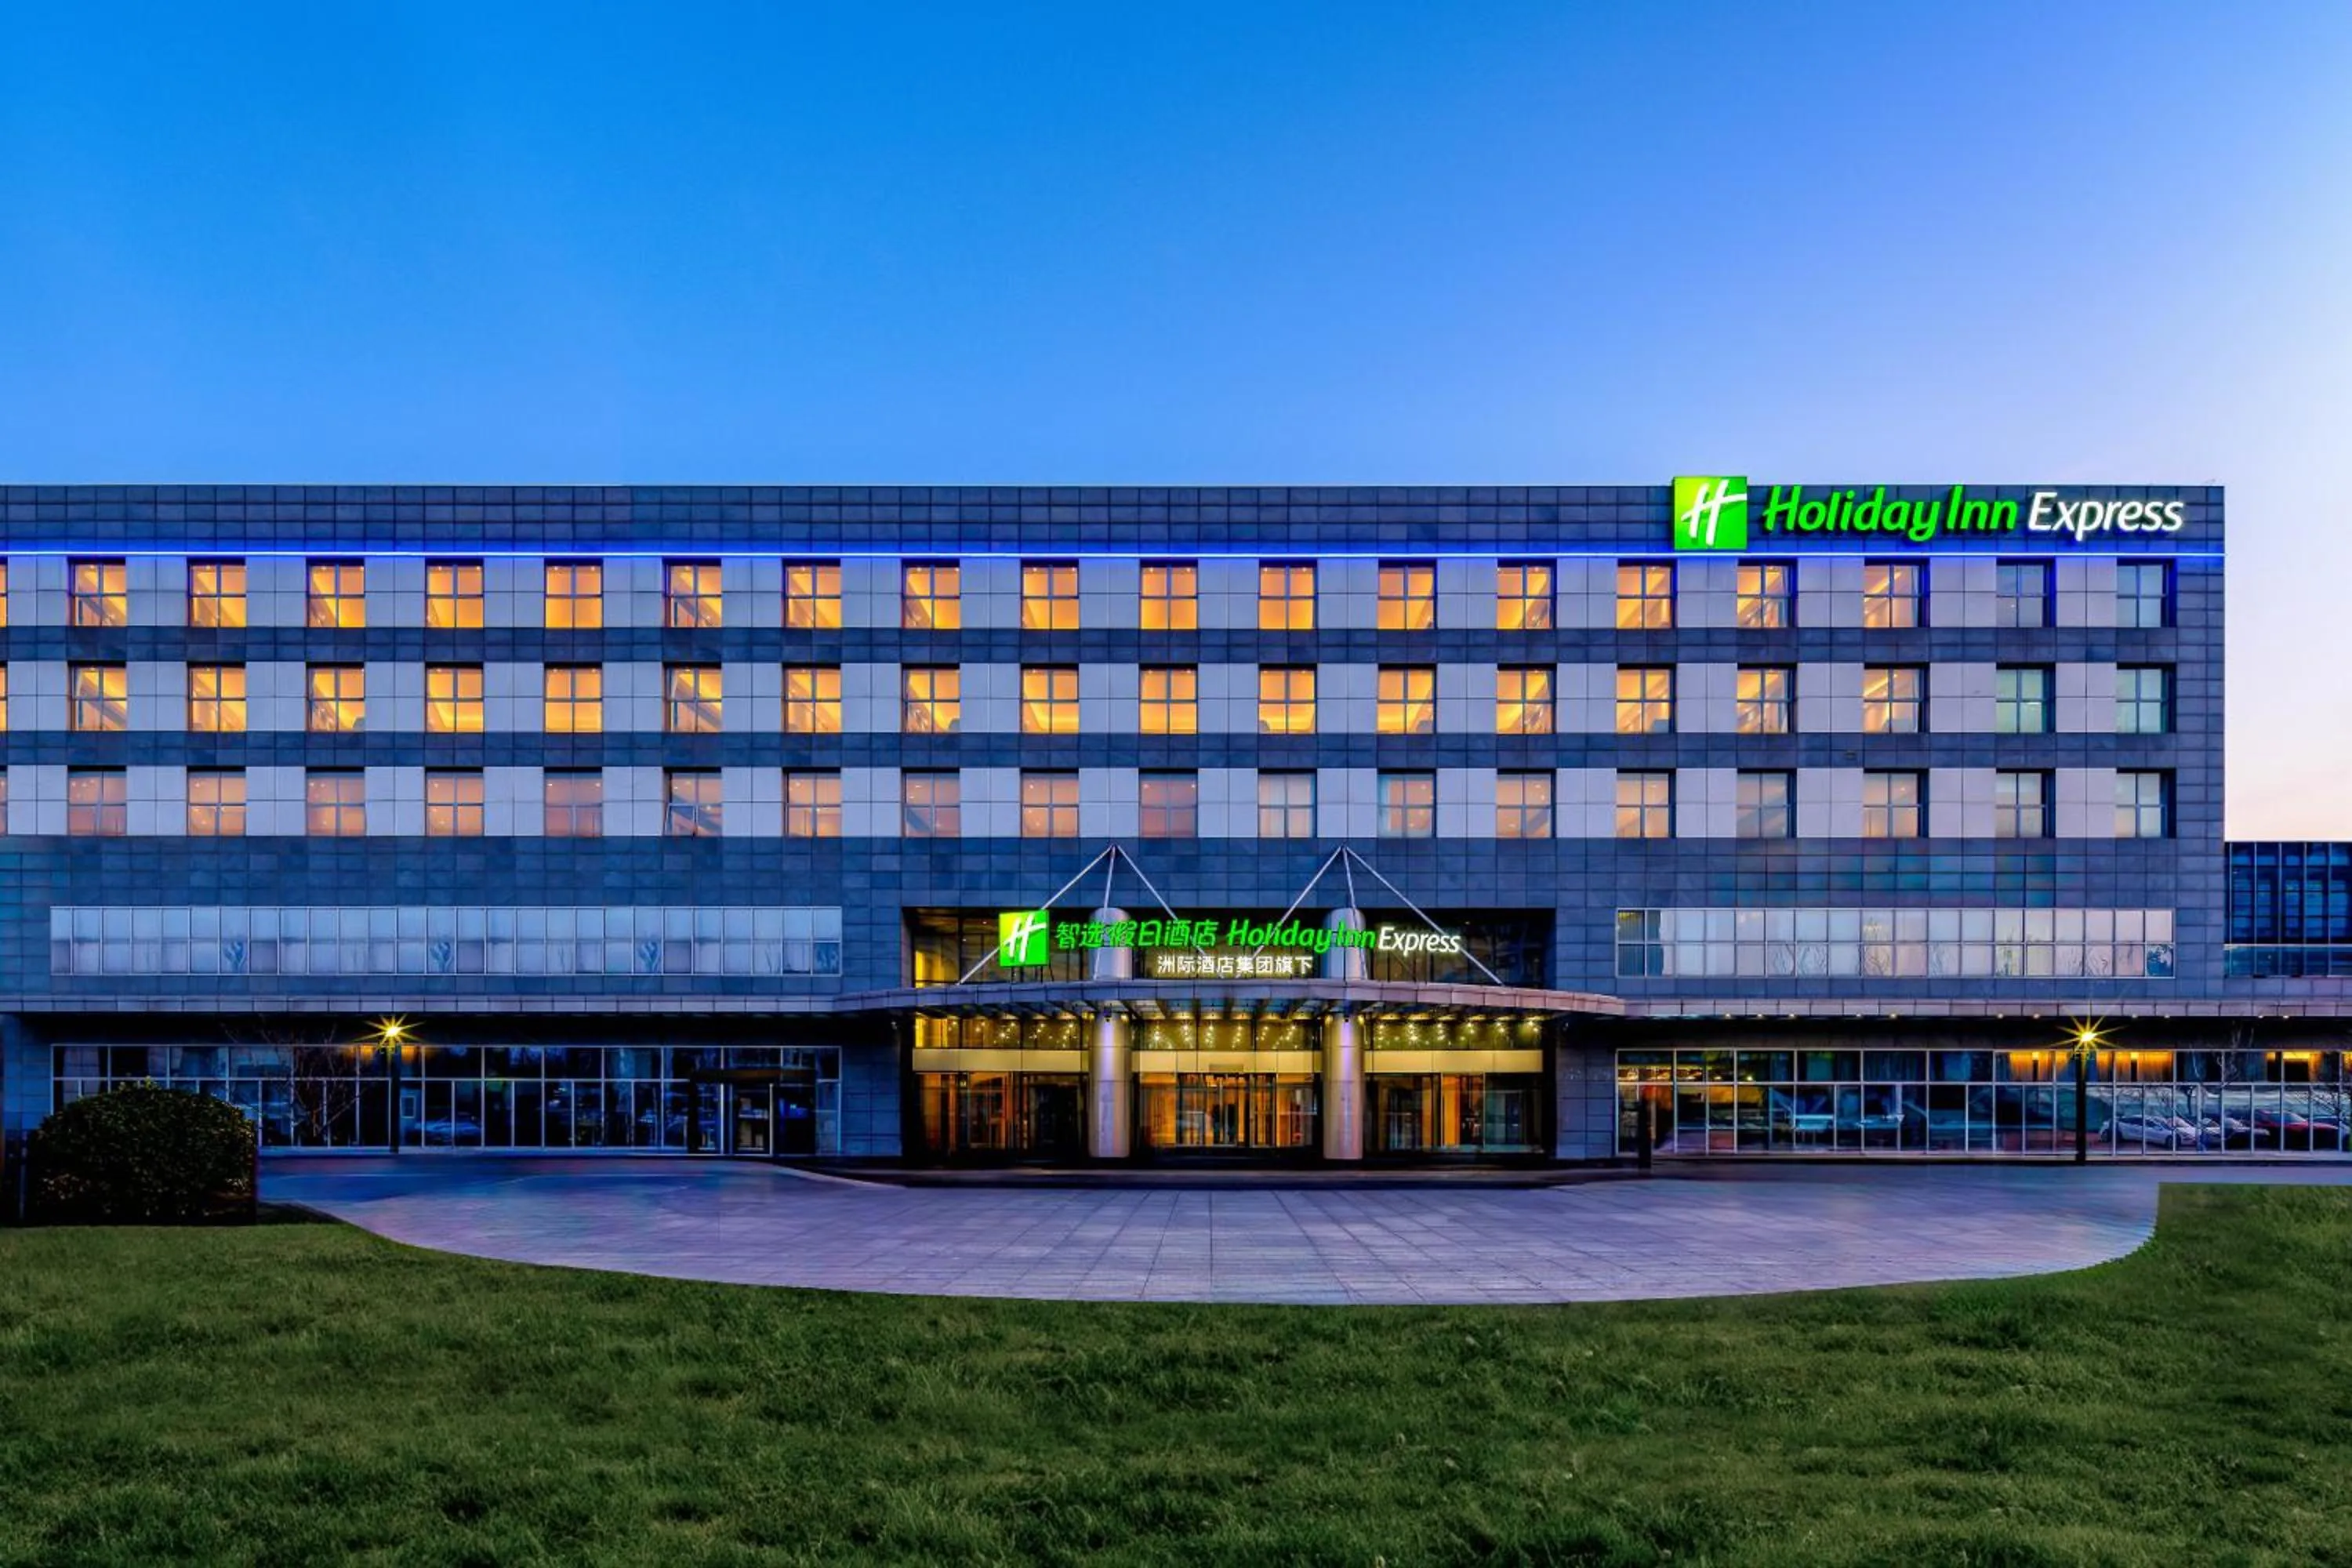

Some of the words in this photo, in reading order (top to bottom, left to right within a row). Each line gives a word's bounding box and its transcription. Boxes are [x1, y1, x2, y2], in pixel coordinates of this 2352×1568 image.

[1764, 484, 1939, 541] Holiday
[1946, 485, 2017, 531] Inn
[2027, 492, 2184, 541] Express
[1227, 919, 1332, 953] Holiday
[1335, 921, 1376, 948] Inn
[1378, 927, 1461, 956] Express
[1156, 955, 1313, 975] 洲际酒店集团旗下
